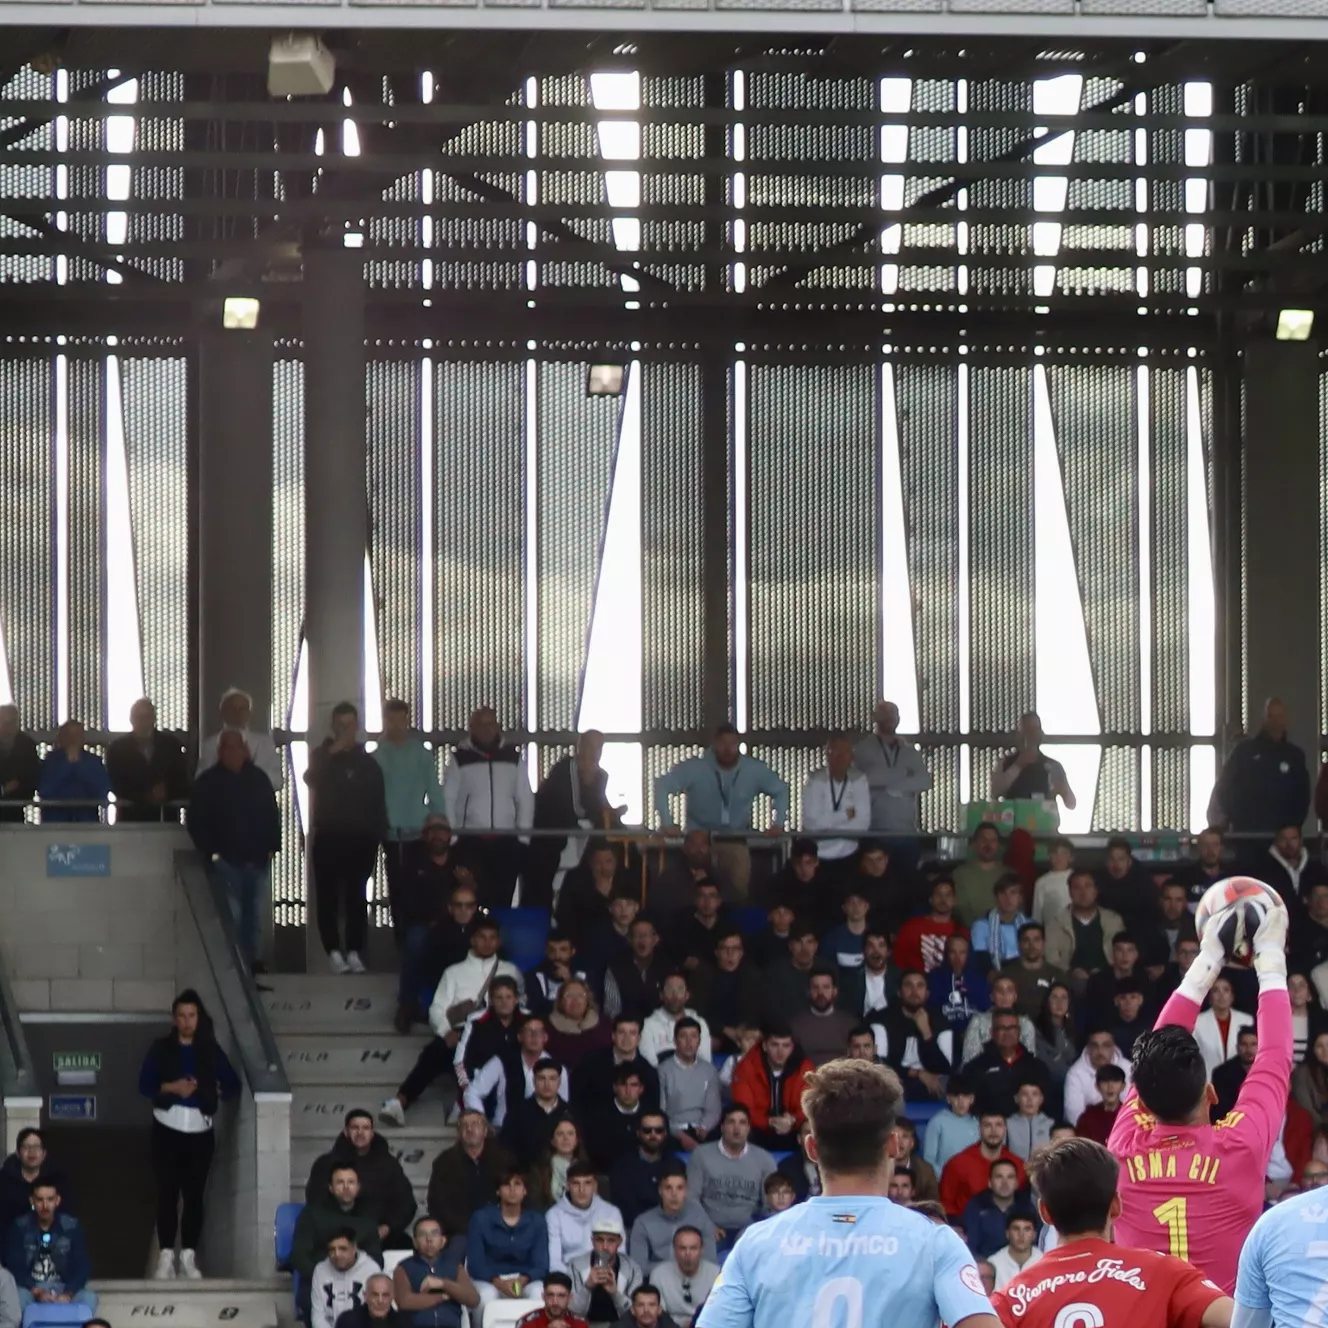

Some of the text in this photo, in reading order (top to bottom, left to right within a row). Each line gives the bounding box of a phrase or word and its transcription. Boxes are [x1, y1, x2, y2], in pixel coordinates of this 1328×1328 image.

[1126, 1152, 1220, 1184] ISMA GIL
[1152, 1196, 1189, 1264] 1
[1008, 1258, 1147, 1317] Siempre Fieles
[131, 1304, 175, 1317] FILA
